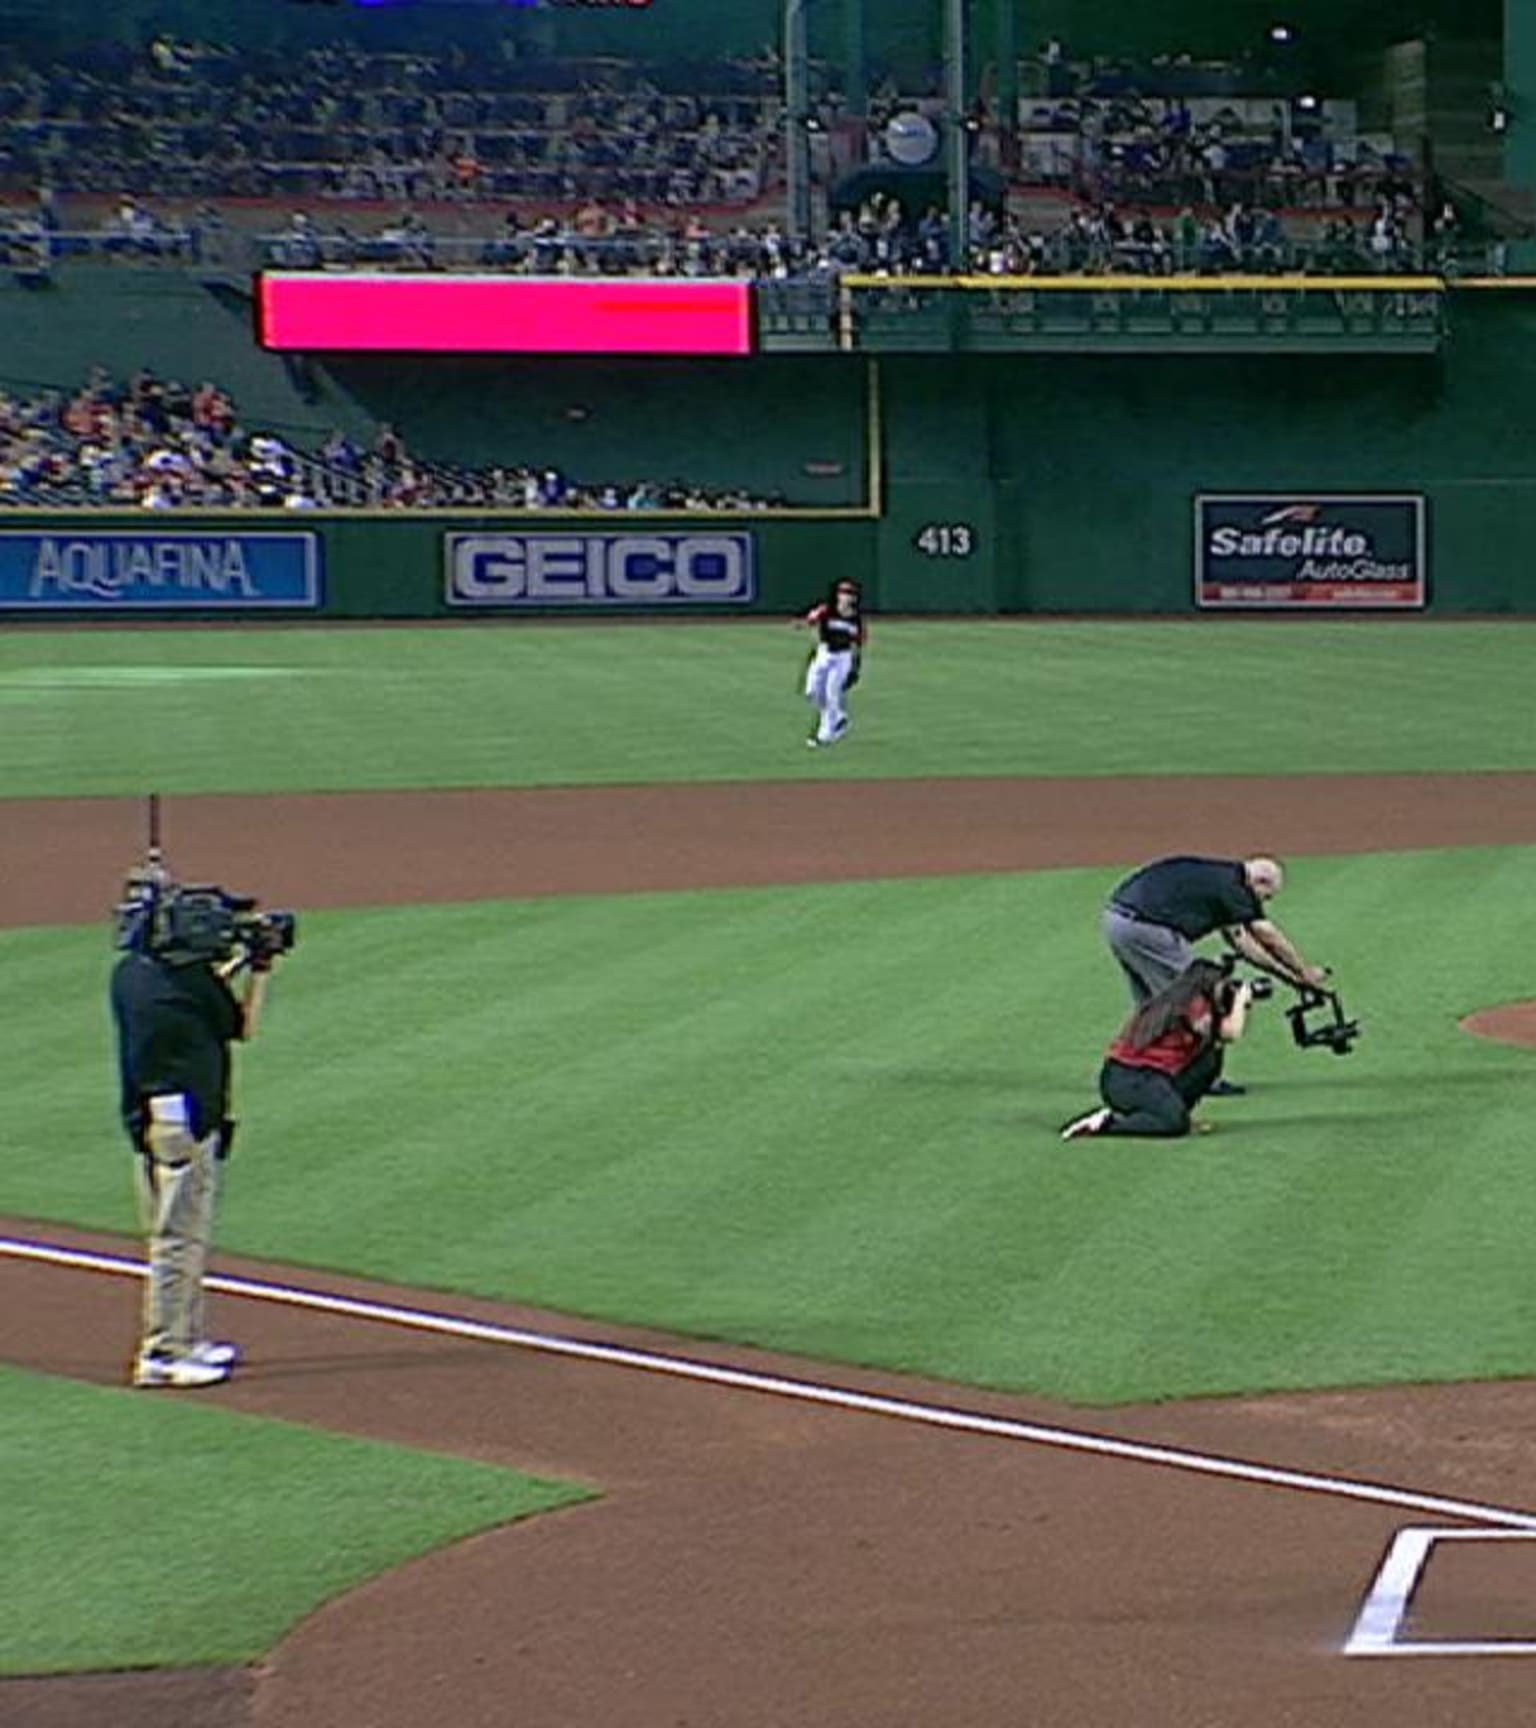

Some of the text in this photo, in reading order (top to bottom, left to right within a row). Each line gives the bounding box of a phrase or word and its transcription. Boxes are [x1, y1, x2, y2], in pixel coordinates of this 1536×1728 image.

[918, 526, 971, 555] 413
[1210, 525, 1368, 556] Safelite
[29, 537, 262, 597] AQUAFINA
[455, 538, 742, 598] GEICO
[1298, 558, 1411, 580] AutoGlass
